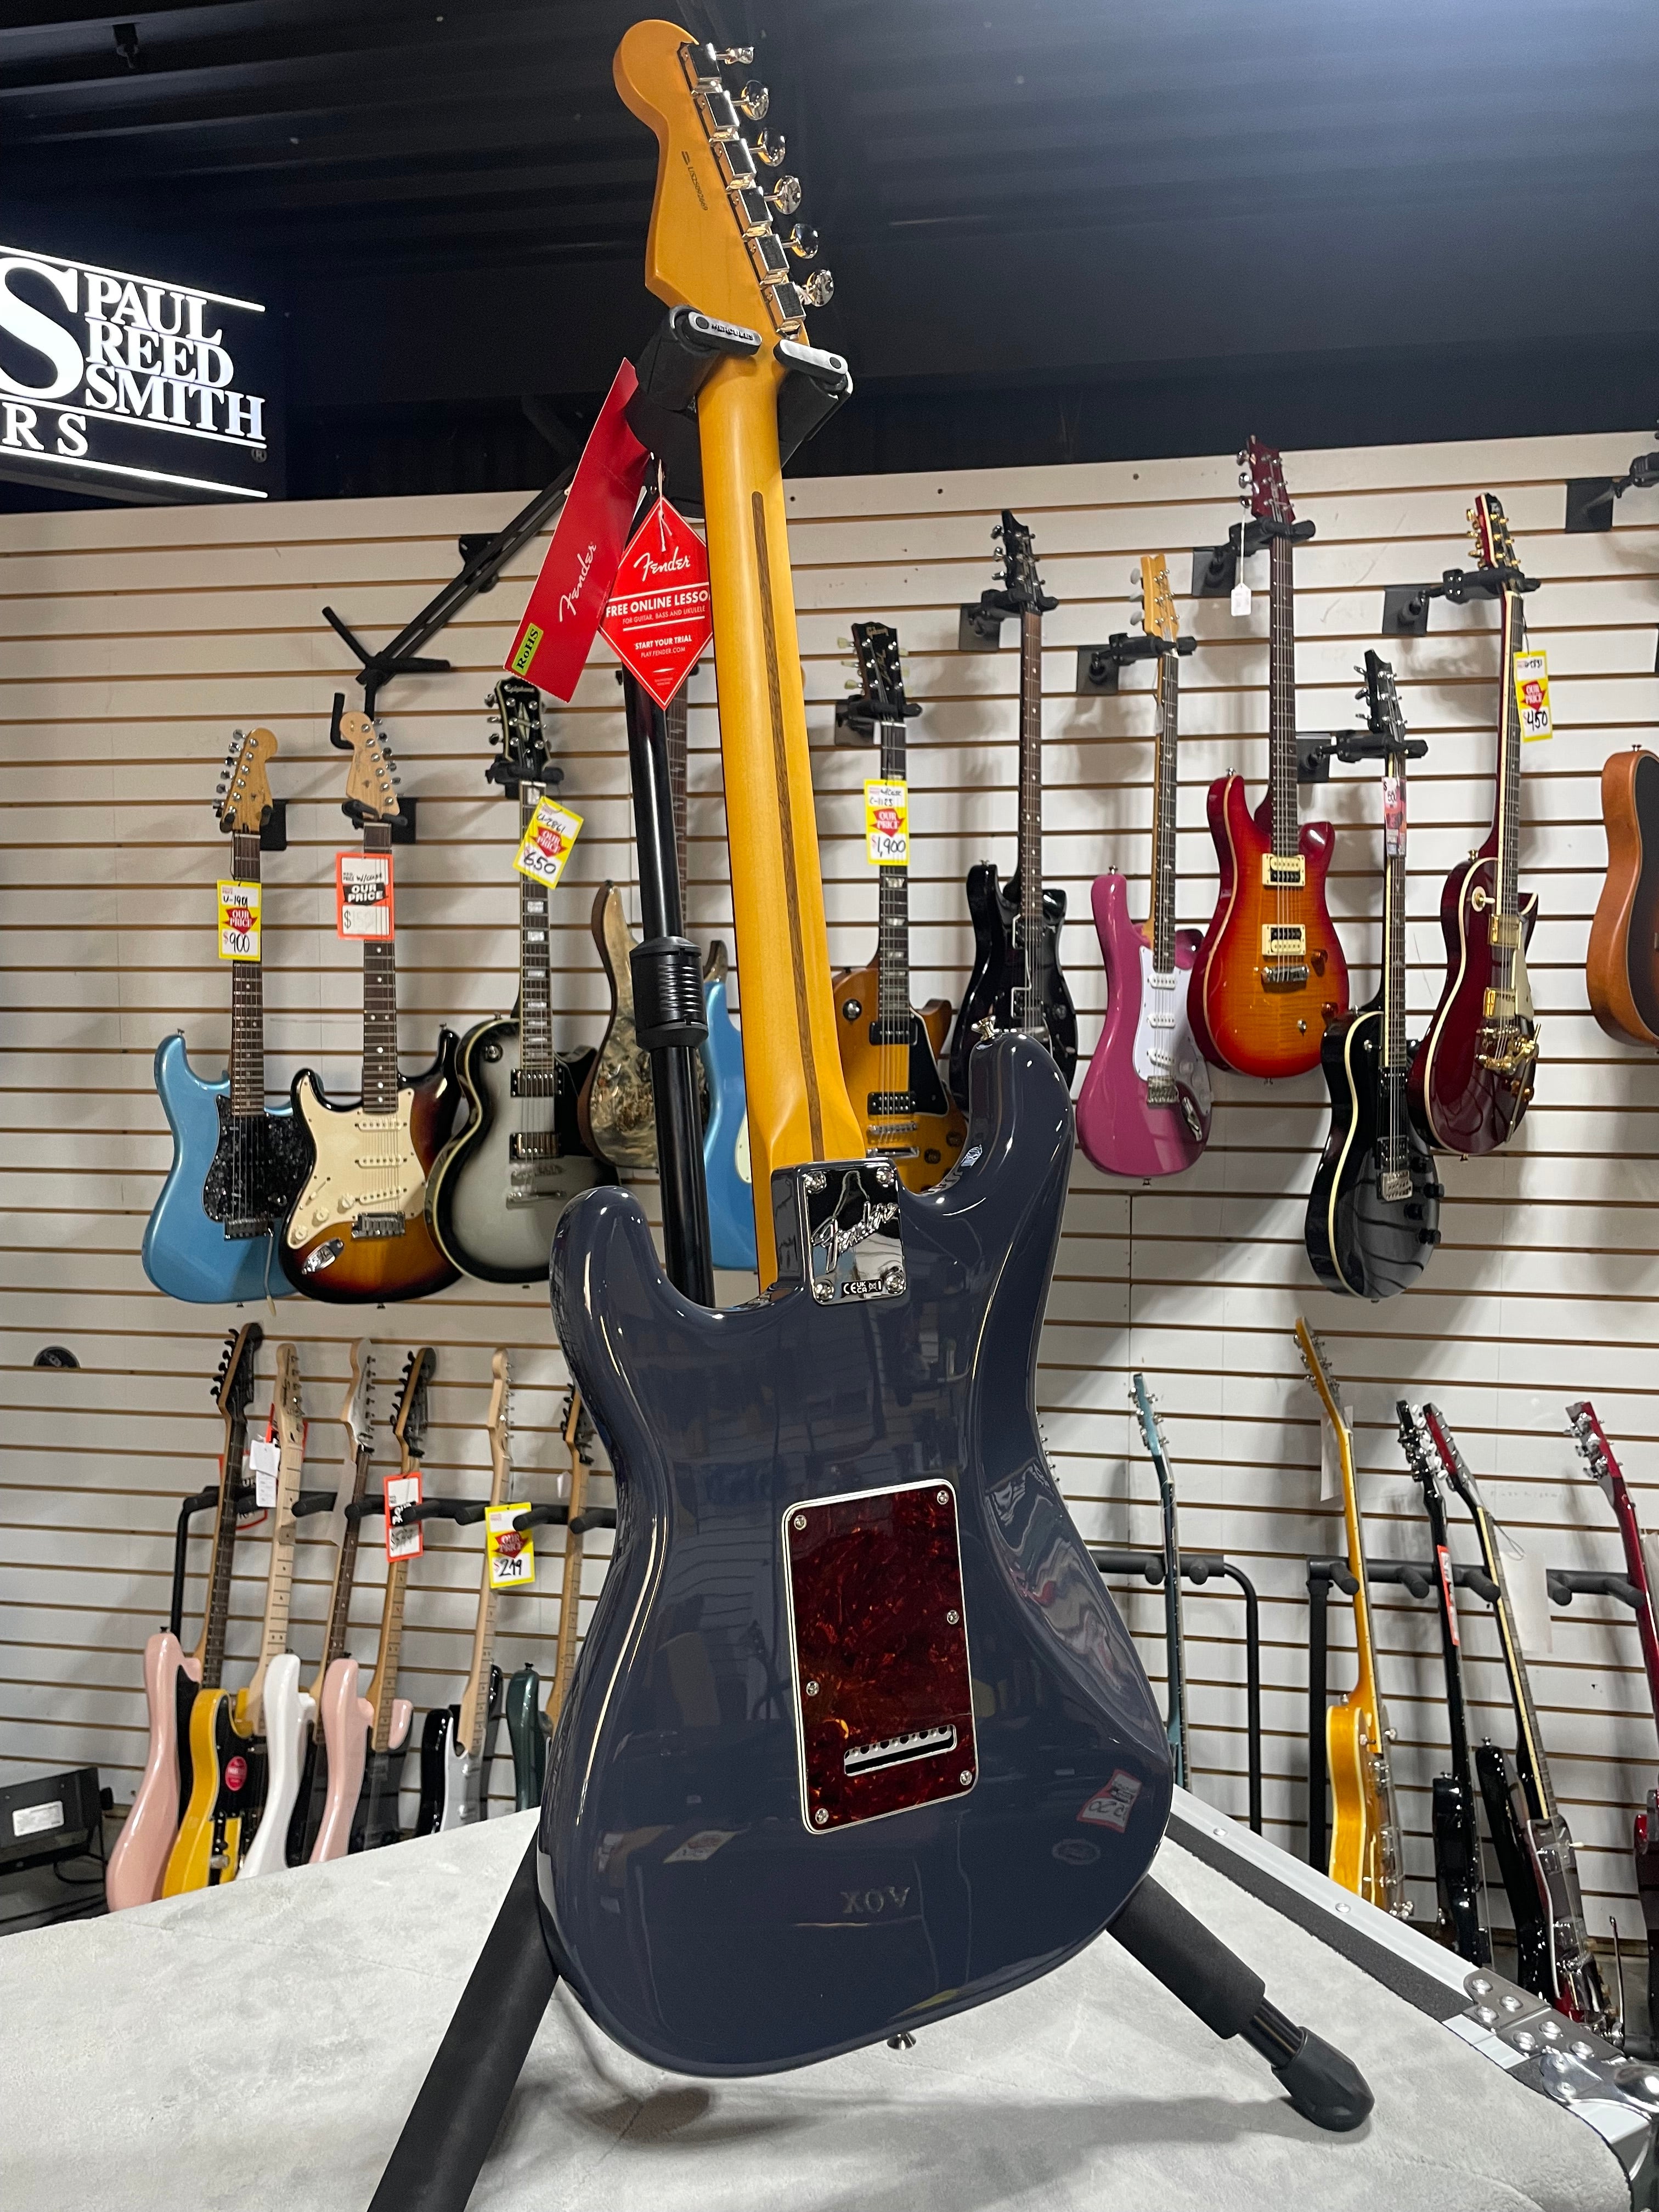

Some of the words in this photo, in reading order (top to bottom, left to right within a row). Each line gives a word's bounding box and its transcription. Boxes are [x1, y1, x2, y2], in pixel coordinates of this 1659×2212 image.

[83, 272, 222, 346] PAUL
[85, 317, 234, 388] REED
[85, 363, 266, 441] SMITH
[633, 546, 691, 582] Fender
[559, 544, 597, 622] Fender
[606, 603, 628, 618] FREE
[630, 594, 672, 613] ONLINE
[674, 590, 710, 606] LESSO
[655, 611, 669, 619] BASS
[683, 605, 706, 614] UKULELE
[635, 642, 653, 650] START
[654, 638, 673, 647] YOUR
[674, 634, 692, 643] TRIAL
[1526, 684, 1540, 694] OUR
[1525, 692, 1543, 704] PRICE
[879, 811, 896, 821] OUR
[877, 820, 900, 830] PRICE
[543, 830, 561, 844] OUR
[537, 836, 561, 853] PRICE
[352, 884, 376, 894] OUR
[348, 890, 383, 903] PRICE
[232, 910, 249, 918] OUR
[230, 917, 252, 928] PRICE
